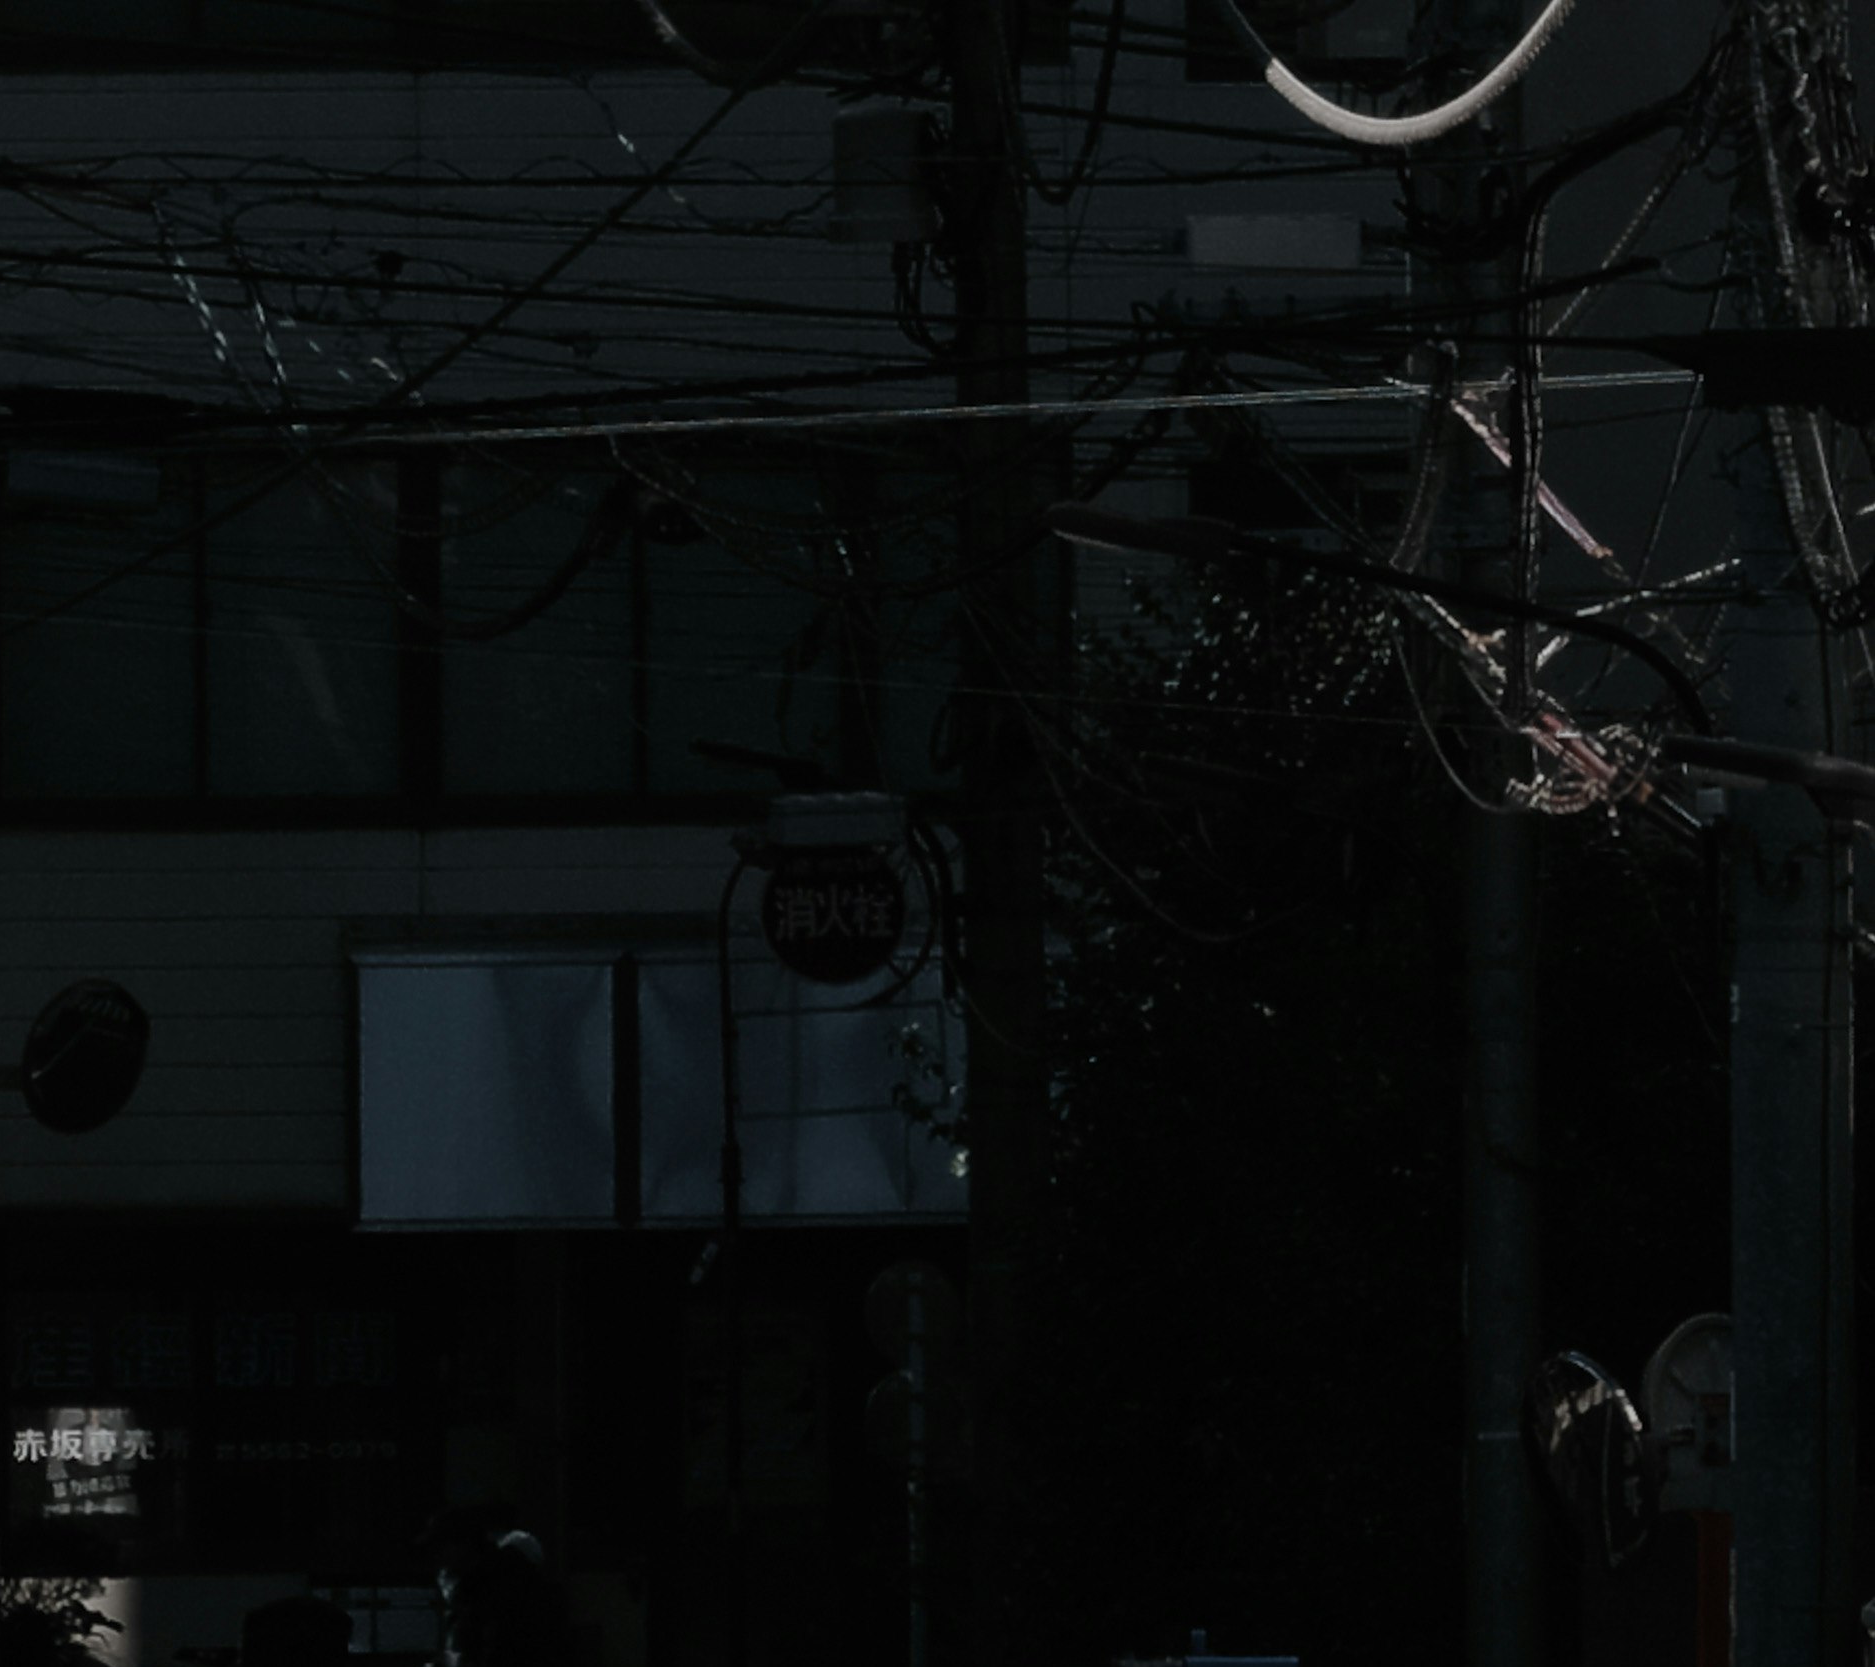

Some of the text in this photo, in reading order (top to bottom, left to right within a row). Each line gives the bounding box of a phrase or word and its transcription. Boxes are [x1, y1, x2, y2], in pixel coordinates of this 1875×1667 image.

[773, 881, 896, 942] 消火栓
[12, 1427, 191, 1465] 赤坂専売所
